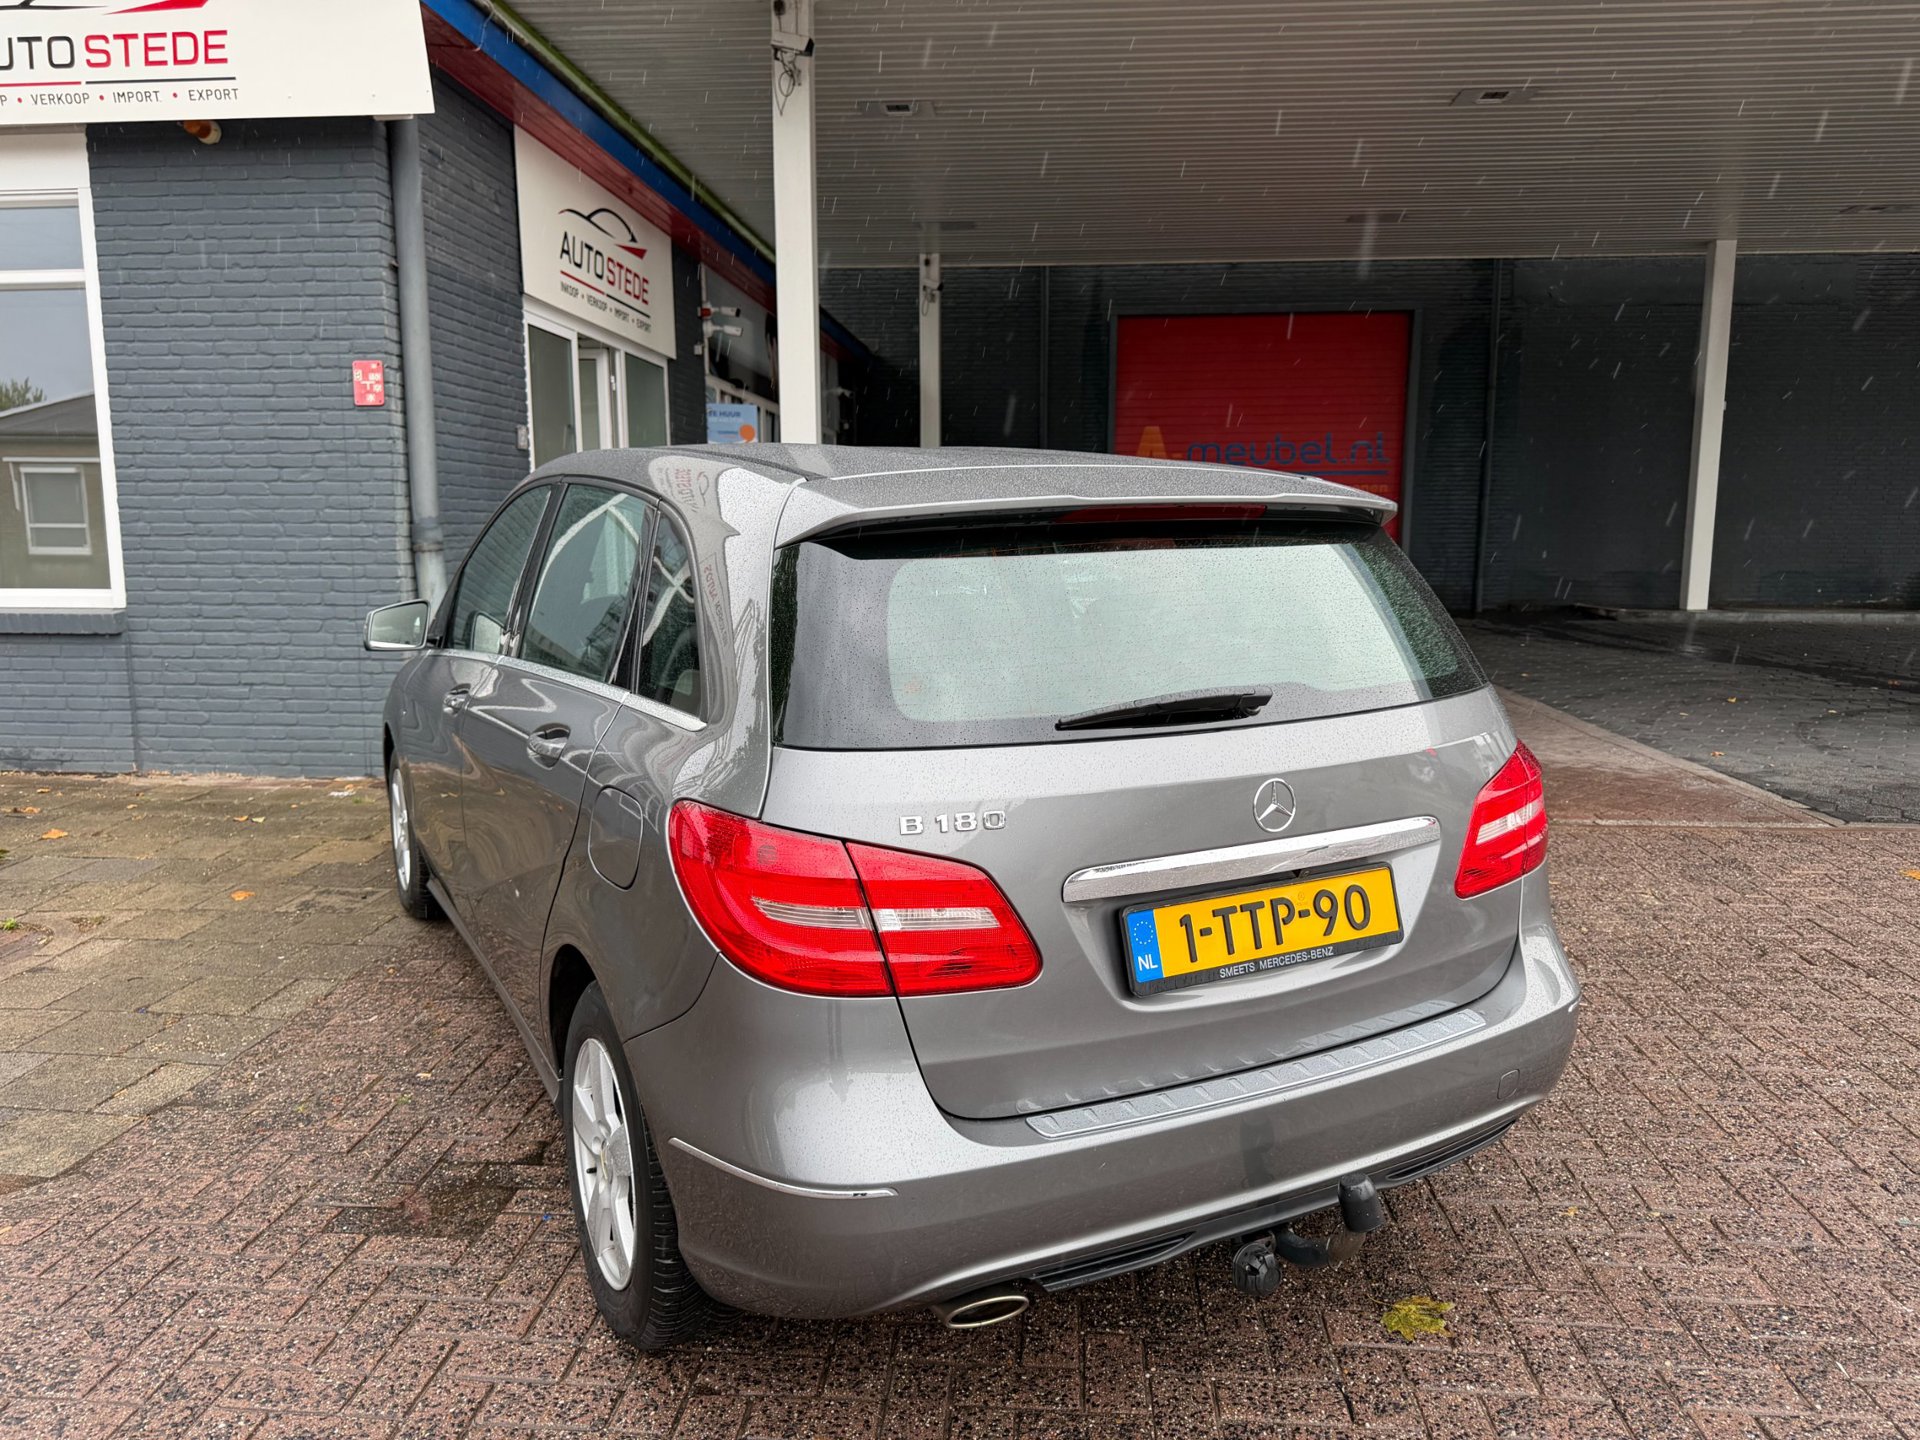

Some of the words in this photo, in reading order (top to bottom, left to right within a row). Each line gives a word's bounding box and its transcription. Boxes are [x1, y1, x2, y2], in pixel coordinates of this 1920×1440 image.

[31, 92, 90, 106] VERKOOP
[113, 90, 161, 104] IMPORT
[189, 88, 239, 102] EXPORT
[560, 281, 579, 298] INKOOP
[587, 294, 607, 313] VERKOOP
[899, 815, 924, 836] B
[934, 810, 1007, 834] 180
[1179, 884, 1371, 963] 1-TTP-90
[1137, 953, 1158, 971] NL
[1219, 962, 1256, 979] SMEETS
[1259, 946, 1335, 971] MERCEDES-BENZ
